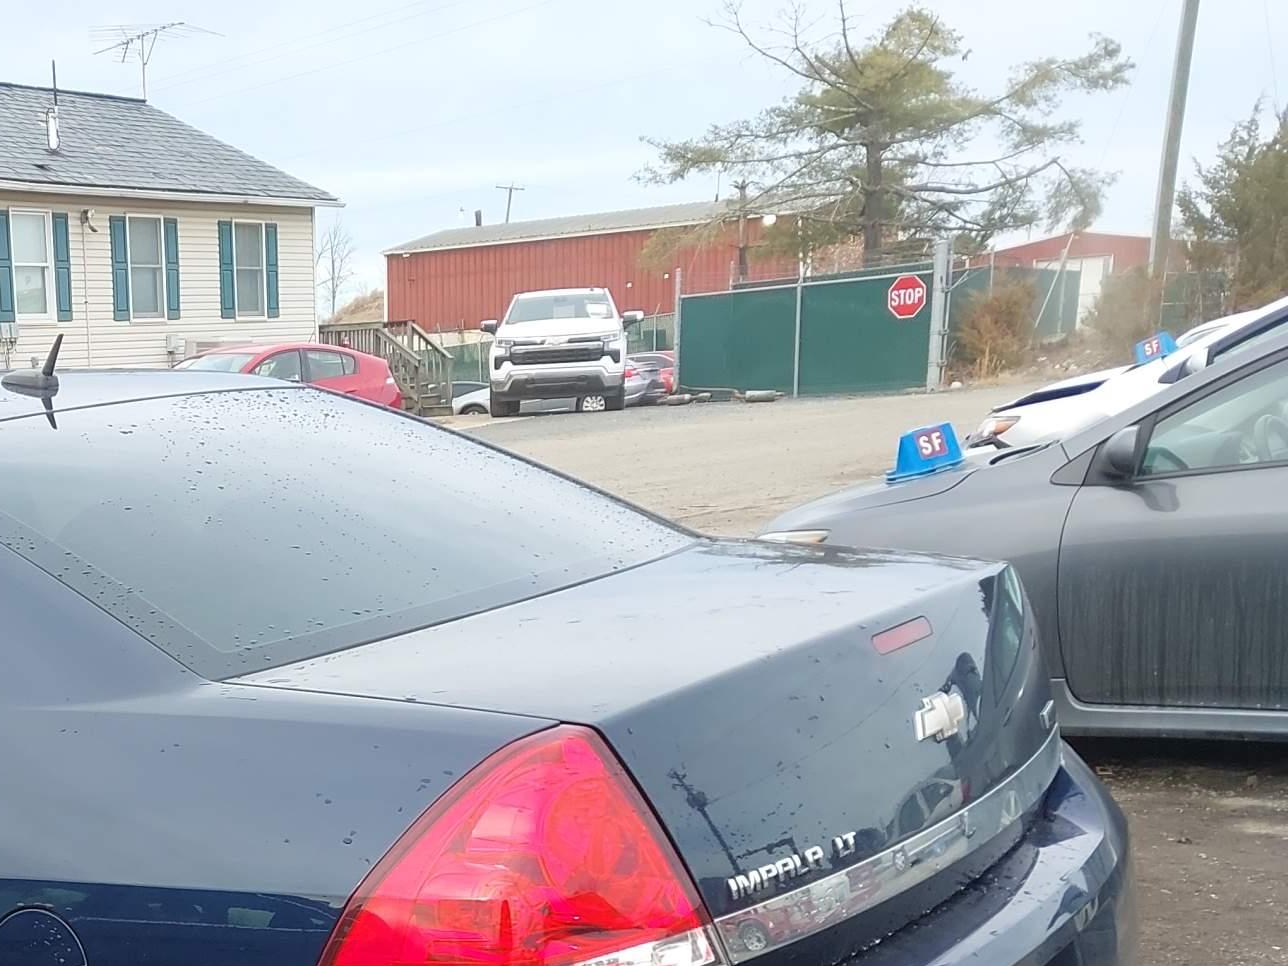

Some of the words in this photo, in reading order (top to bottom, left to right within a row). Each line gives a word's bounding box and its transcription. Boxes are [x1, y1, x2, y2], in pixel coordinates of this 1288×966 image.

[891, 287, 923, 306] STOP
[1144, 340, 1159, 356] SF
[919, 431, 942, 456] SF
[727, 845, 824, 900] IMPALA
[832, 831, 857, 858] LT
